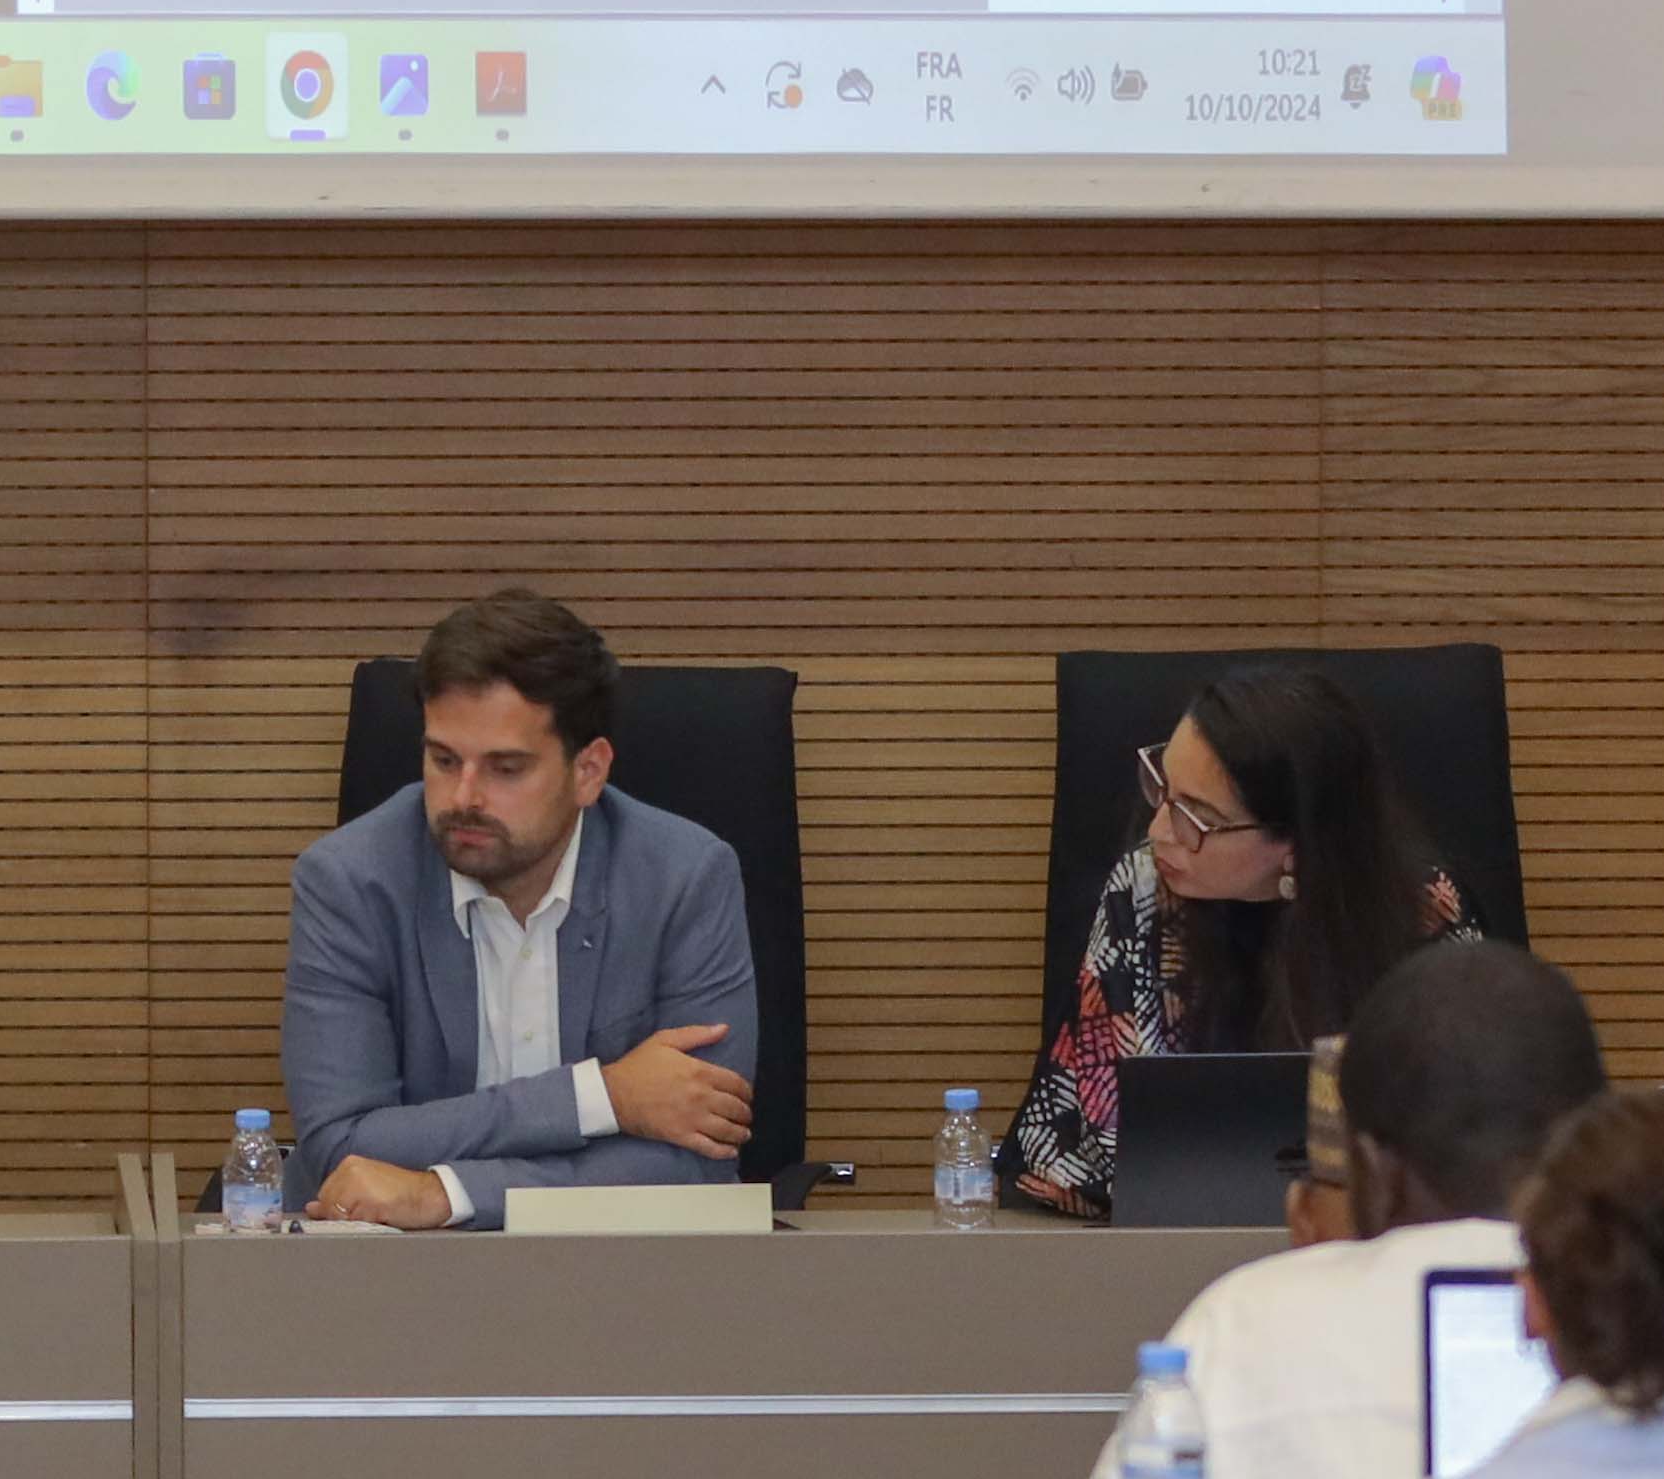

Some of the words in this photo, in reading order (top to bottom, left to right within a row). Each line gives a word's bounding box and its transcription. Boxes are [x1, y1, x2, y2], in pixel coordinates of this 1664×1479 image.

[917, 52, 962, 78] FRA
[1259, 49, 1320, 75] 10:21
[926, 95, 954, 122] FR
[1186, 93, 1321, 123] 10/10/2024
